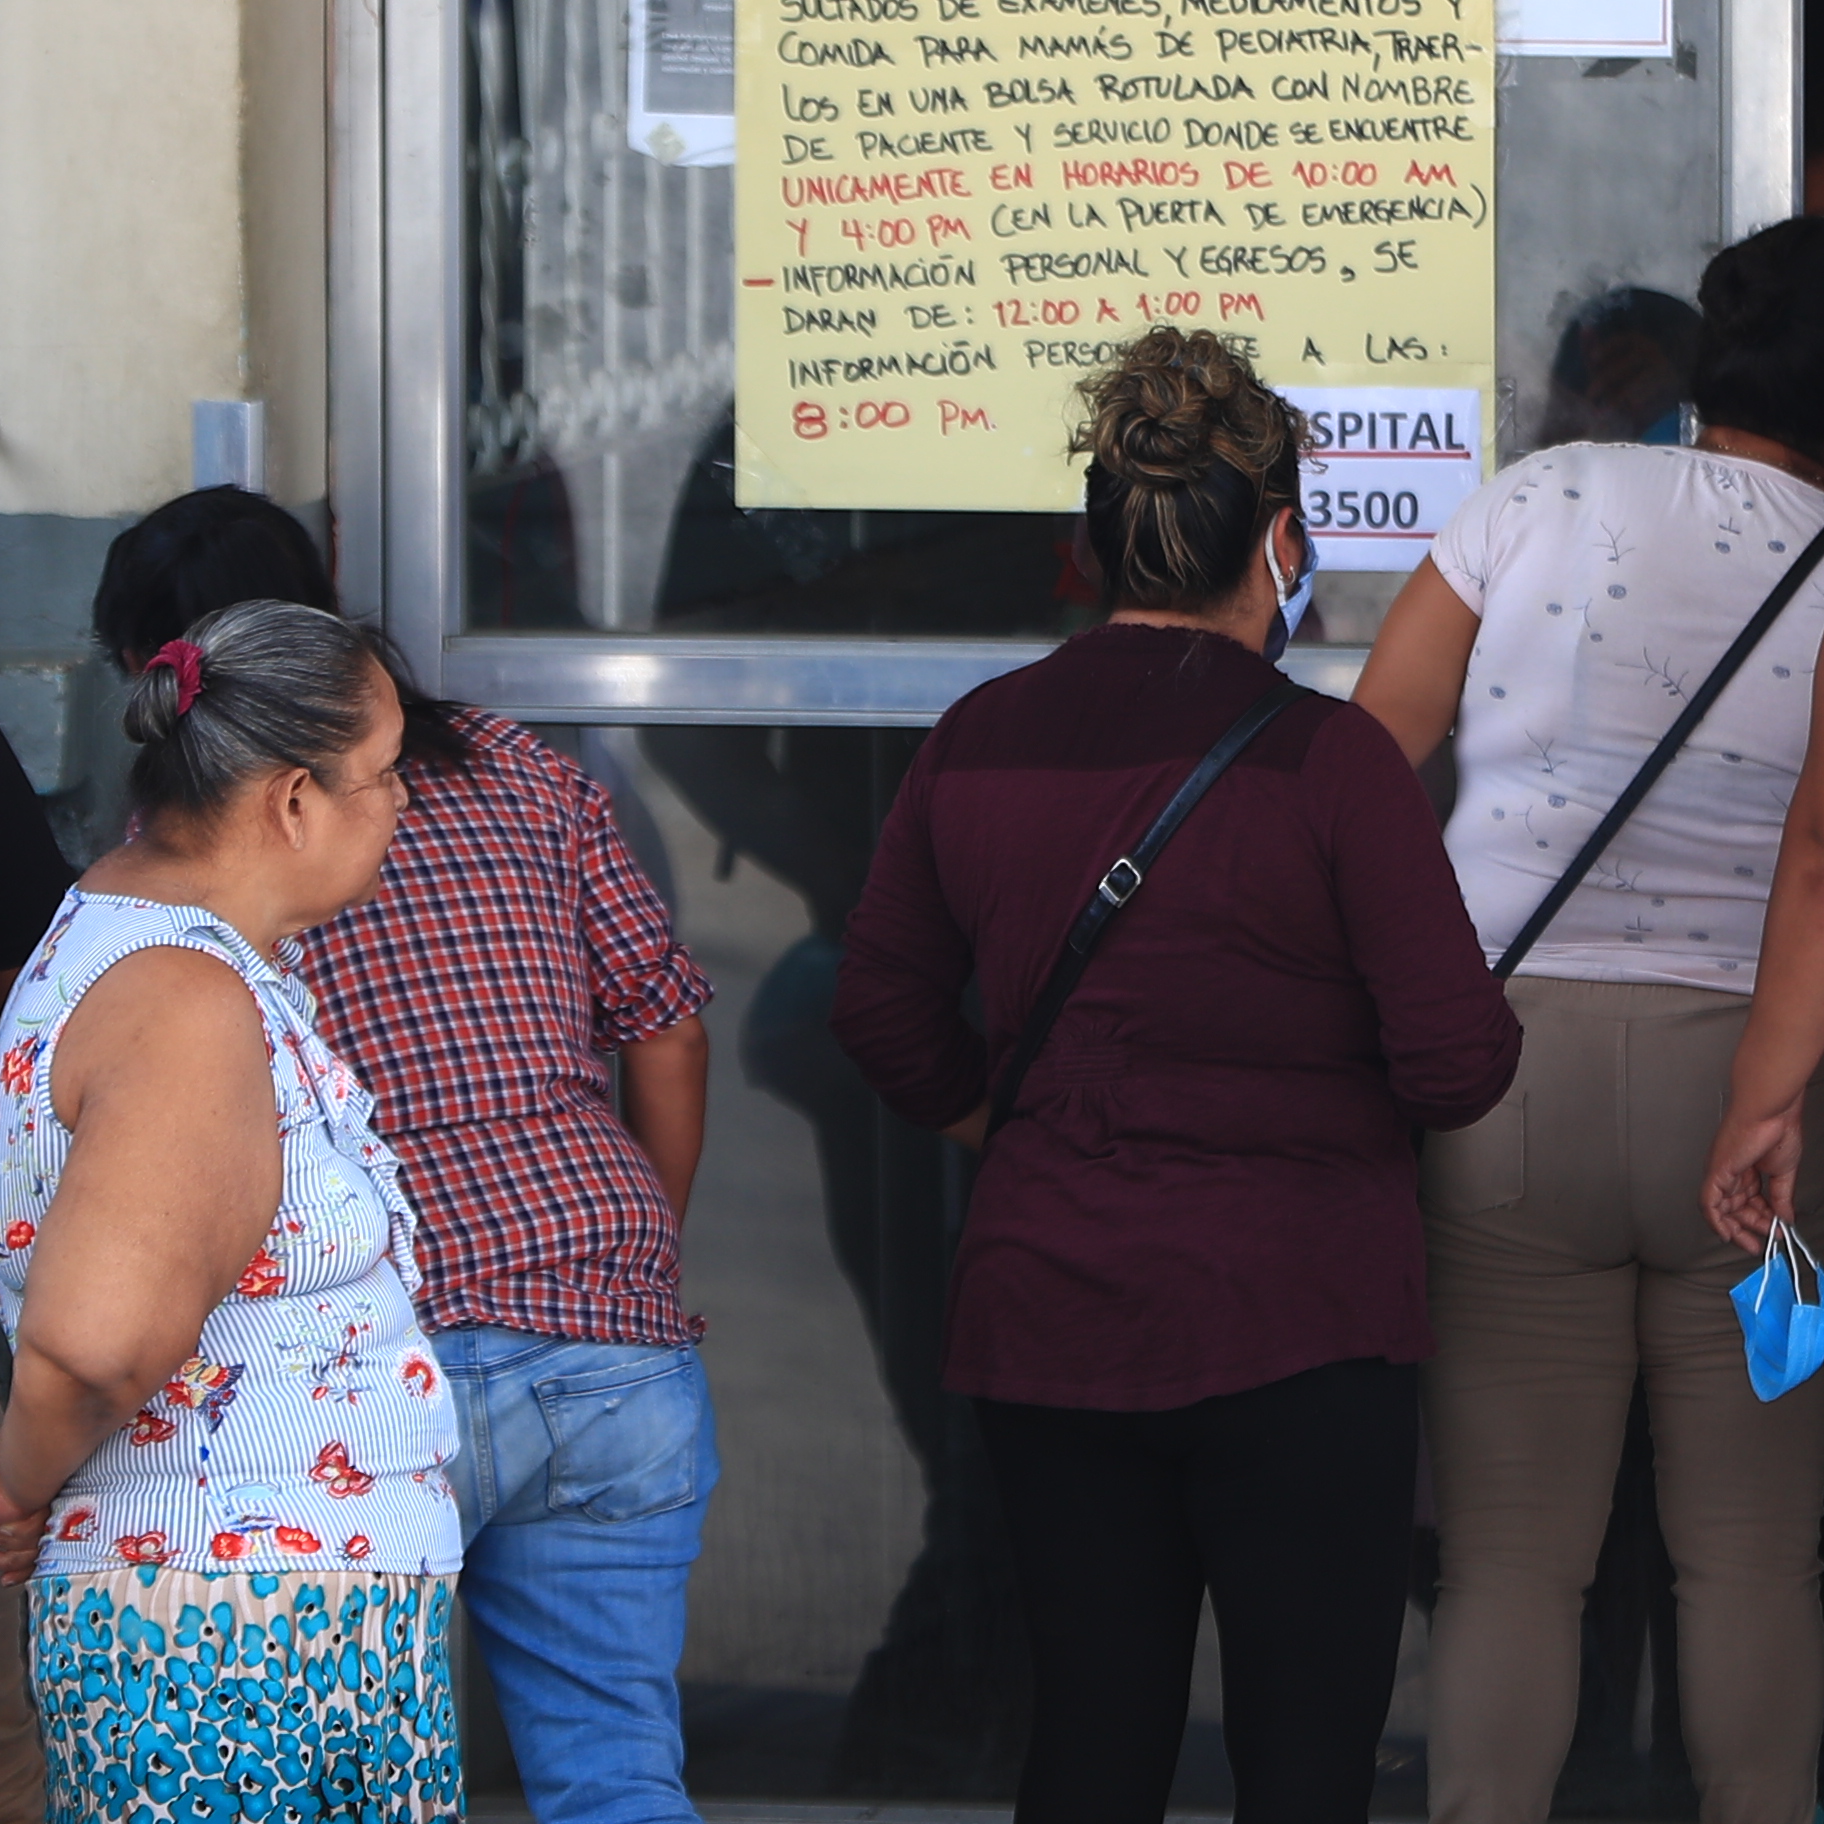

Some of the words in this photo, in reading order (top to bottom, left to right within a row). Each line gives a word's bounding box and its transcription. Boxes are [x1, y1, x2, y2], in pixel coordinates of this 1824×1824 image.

[777, 30, 896, 68] COMIDA
[915, 34, 999, 69] PARA
[1019, 25, 1133, 61] MAMÁS
[1154, 30, 1195, 59] DE
[781, 83, 840, 124] LOS
[857, 88, 896, 118] EN
[908, 85, 969, 115] UNA
[982, 77, 1077, 109] BOLSA
[1093, 73, 1256, 103] ROTULADA
[1271, 70, 1330, 102] CON
[1342, 72, 1475, 106] NOMBRE
[782, 134, 834, 166] DE
[855, 128, 994, 160] PACIENTE
[1014, 122, 1032, 154] Y
[1053, 117, 1171, 148] SERVICIO
[1183, 117, 1279, 152] DONDE
[1288, 121, 1325, 145] SE
[1328, 114, 1474, 143] ENCUENTRE
[781, 167, 973, 208] UNICAMENTE
[989, 162, 1034, 191] EN
[1062, 157, 1200, 190] HORARIOS
[1223, 160, 1273, 191] DE
[1292, 160, 1378, 189] 10:00
[1404, 159, 1458, 188] AM
[786, 217, 809, 257] Y
[841, 218, 916, 252] 4:00
[926, 213, 972, 247] PM
[1068, 201, 1107, 229] LA
[1116, 196, 1226, 233] PUERTA
[1243, 202, 1287, 232] DE
[1301, 183, 1487, 230] EMERGENCIA)
[999, 247, 1150, 286] PERSONAL
[1168, 245, 1190, 279] Y
[1373, 239, 1419, 274] SE
[782, 305, 877, 338] DARAN
[905, 303, 974, 330] DE:
[992, 298, 1080, 328] 12:00
[1096, 297, 1120, 323] A
[1136, 290, 1201, 321] 1:00
[1219, 292, 1265, 322] PM
[1301, 336, 1326, 366] A
[1365, 332, 1448, 365] LAS:
[792, 400, 912, 441] 8:00
[1310, 411, 1465, 450] SPITAL
